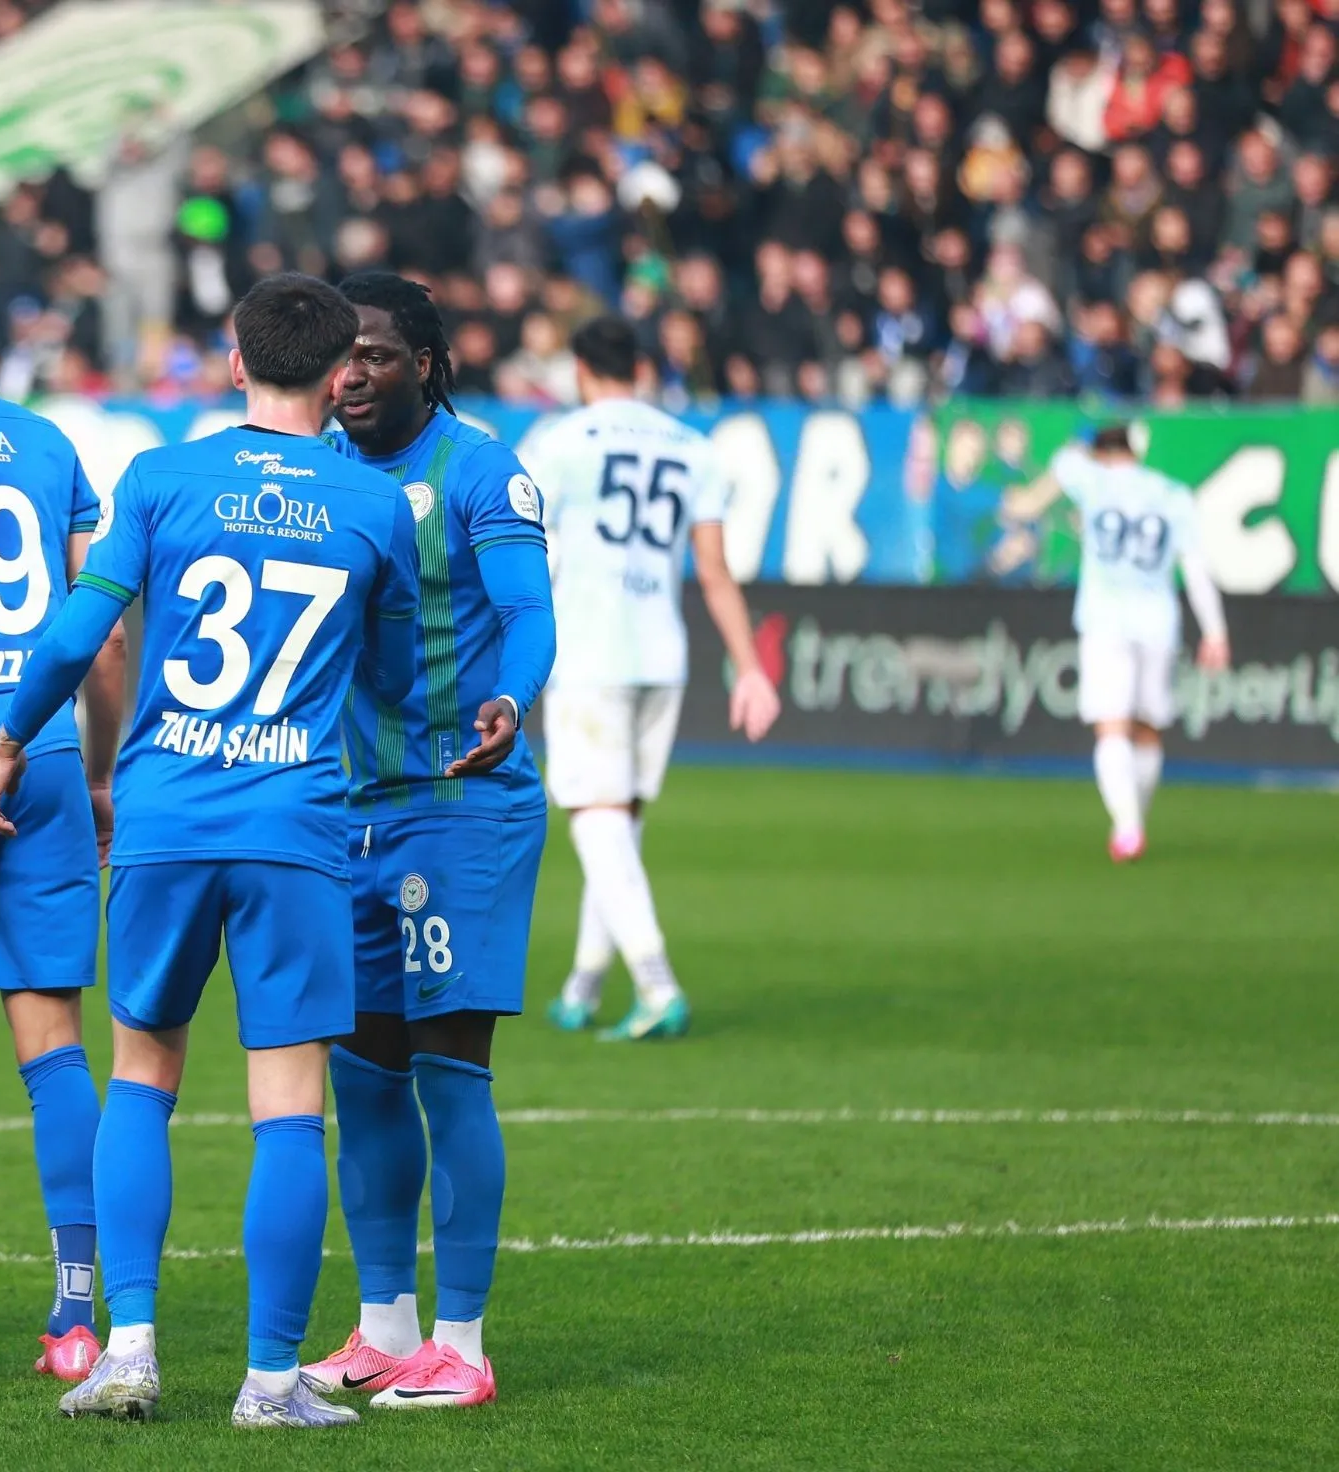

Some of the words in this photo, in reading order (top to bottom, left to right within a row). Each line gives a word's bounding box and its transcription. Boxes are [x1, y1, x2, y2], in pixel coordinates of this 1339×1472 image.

[261, 461, 317, 477] Rizespor
[214, 489, 334, 533] GLORIA
[596, 454, 689, 550] 55
[223, 521, 265, 536] HOTELS
[266, 526, 275, 536] &
[277, 527, 323, 543] RESORTS
[1093, 509, 1171, 572] 99
[163, 555, 349, 716] 37
[153, 711, 222, 757] TAHA
[222, 717, 308, 769] ŞAHİN
[401, 915, 453, 973] 28
